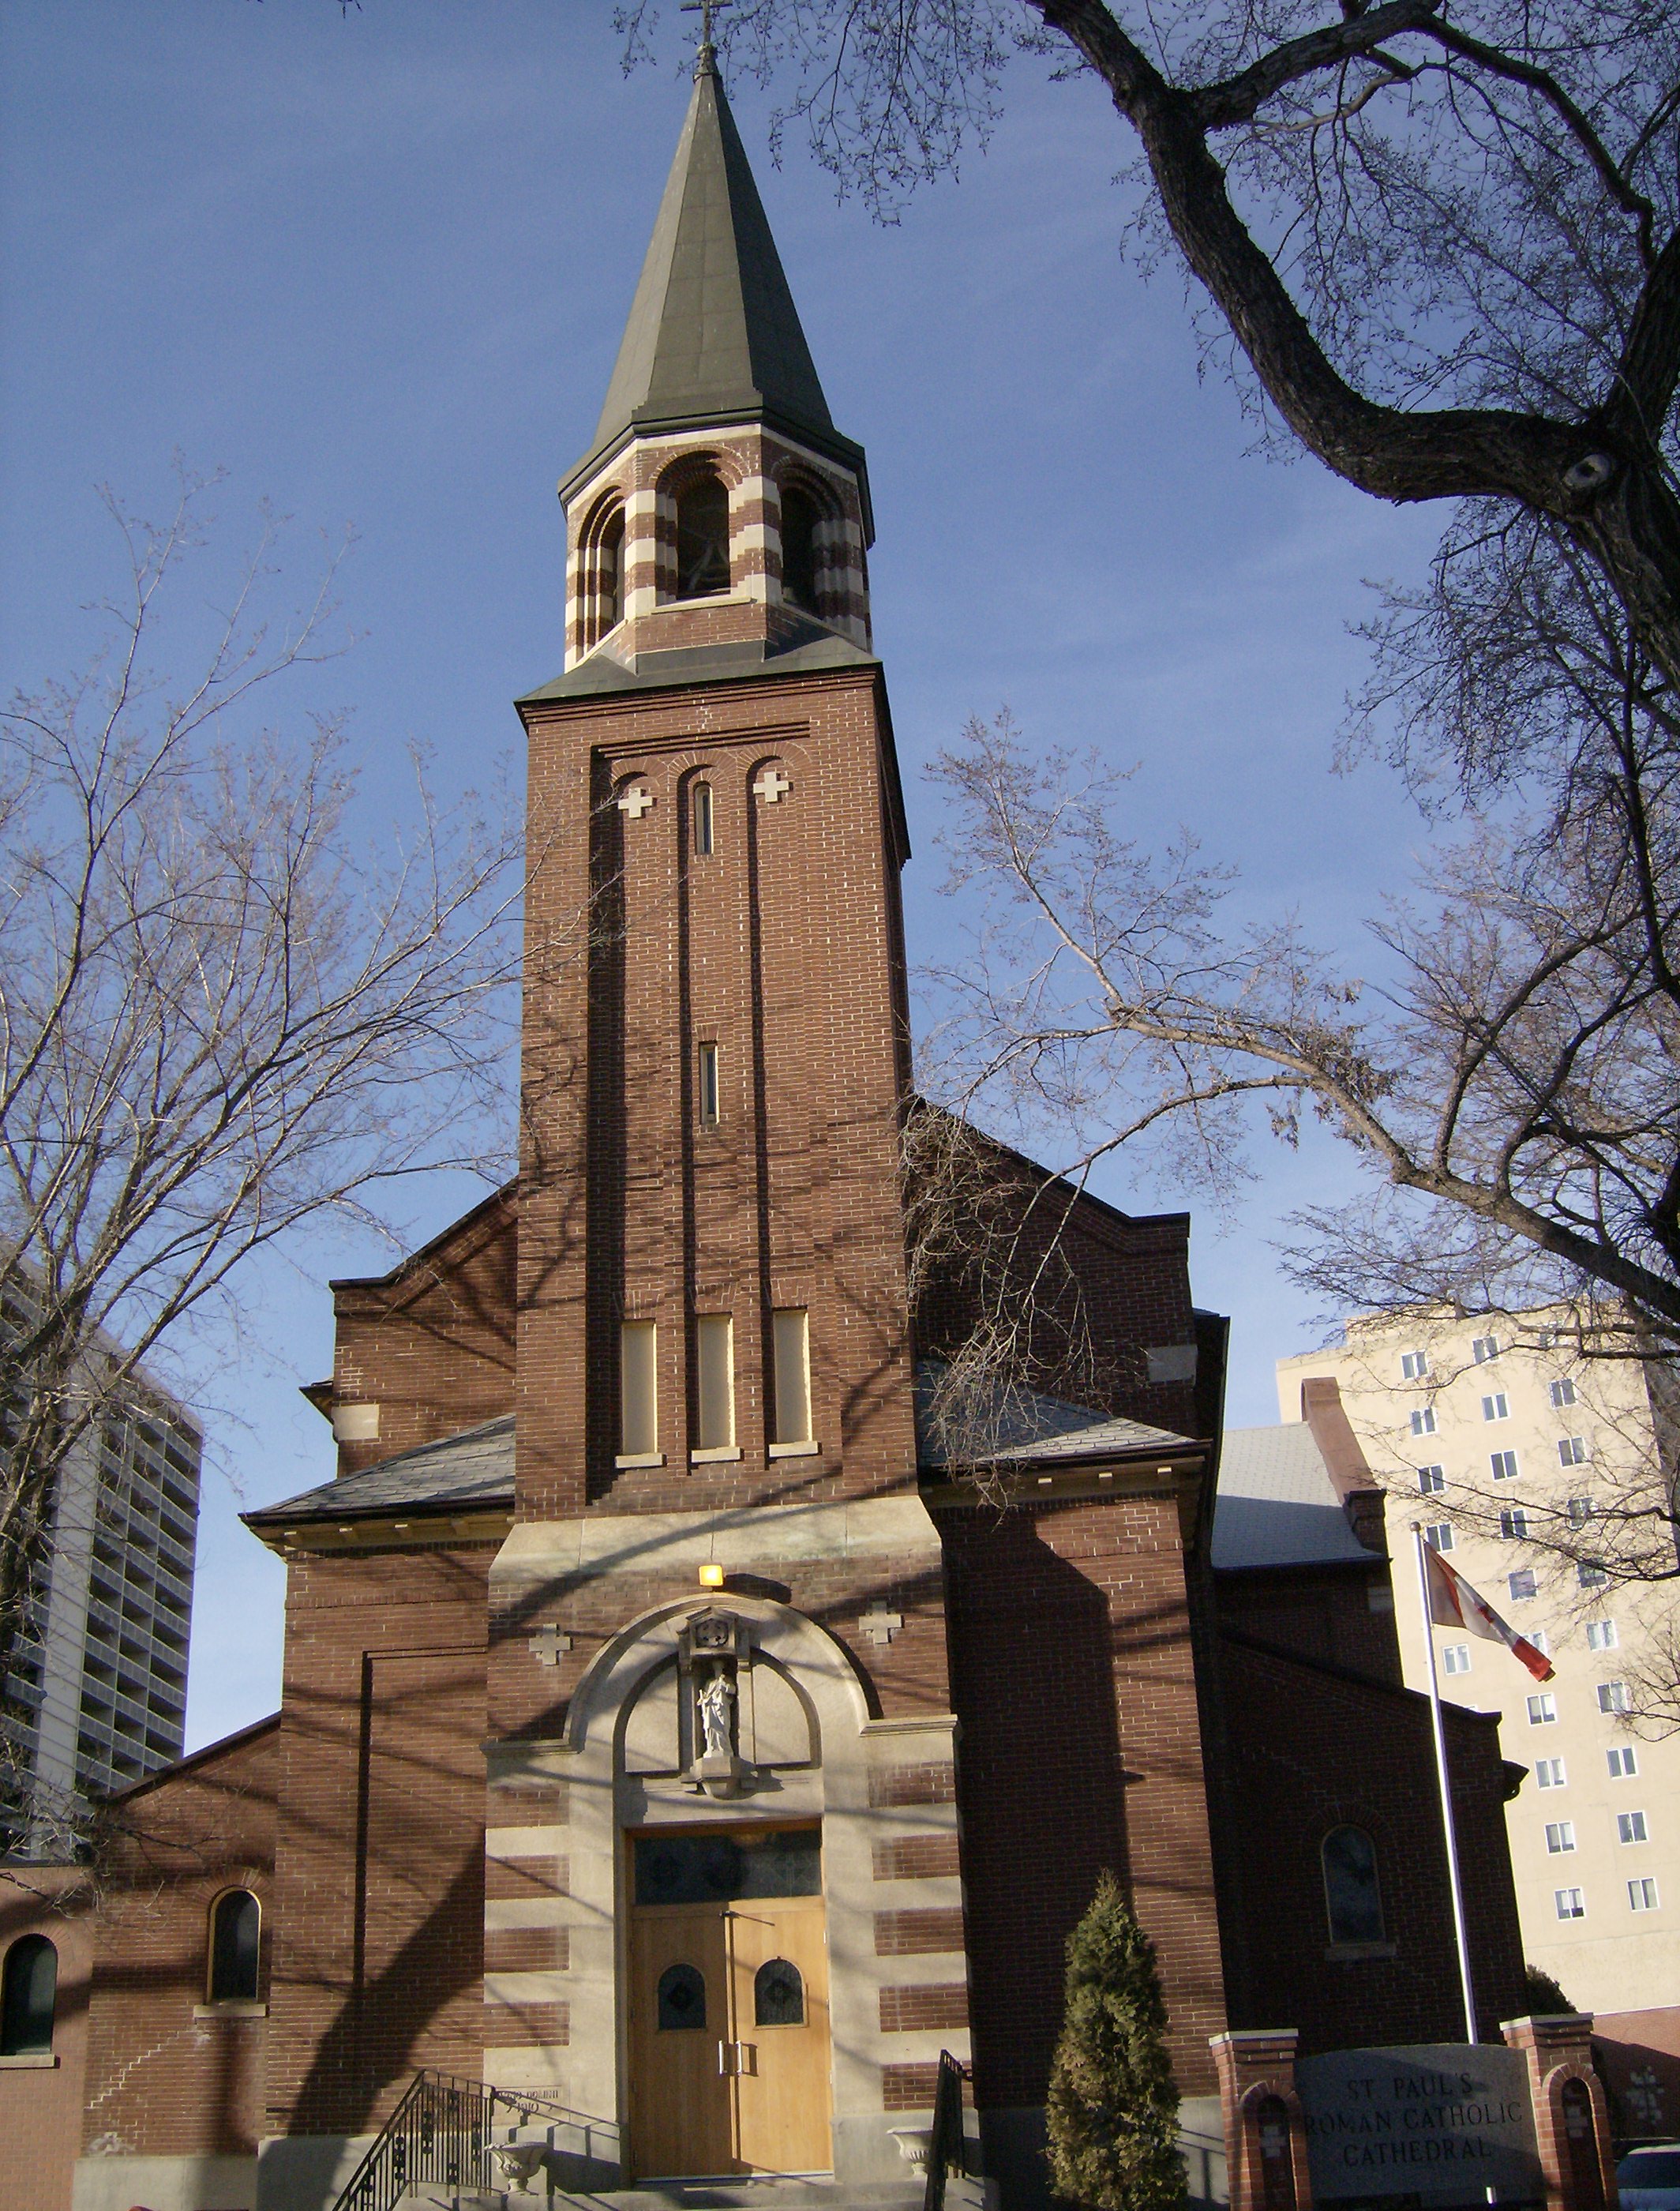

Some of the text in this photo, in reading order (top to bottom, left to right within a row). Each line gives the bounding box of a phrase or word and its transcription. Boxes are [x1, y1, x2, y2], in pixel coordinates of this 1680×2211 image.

[1393, 2073, 1473, 2100] PAUL'S
[1303, 2101, 1523, 2137] ROMAN CATHOLIC
[1344, 2137, 1492, 2167] CATHEDRAL
